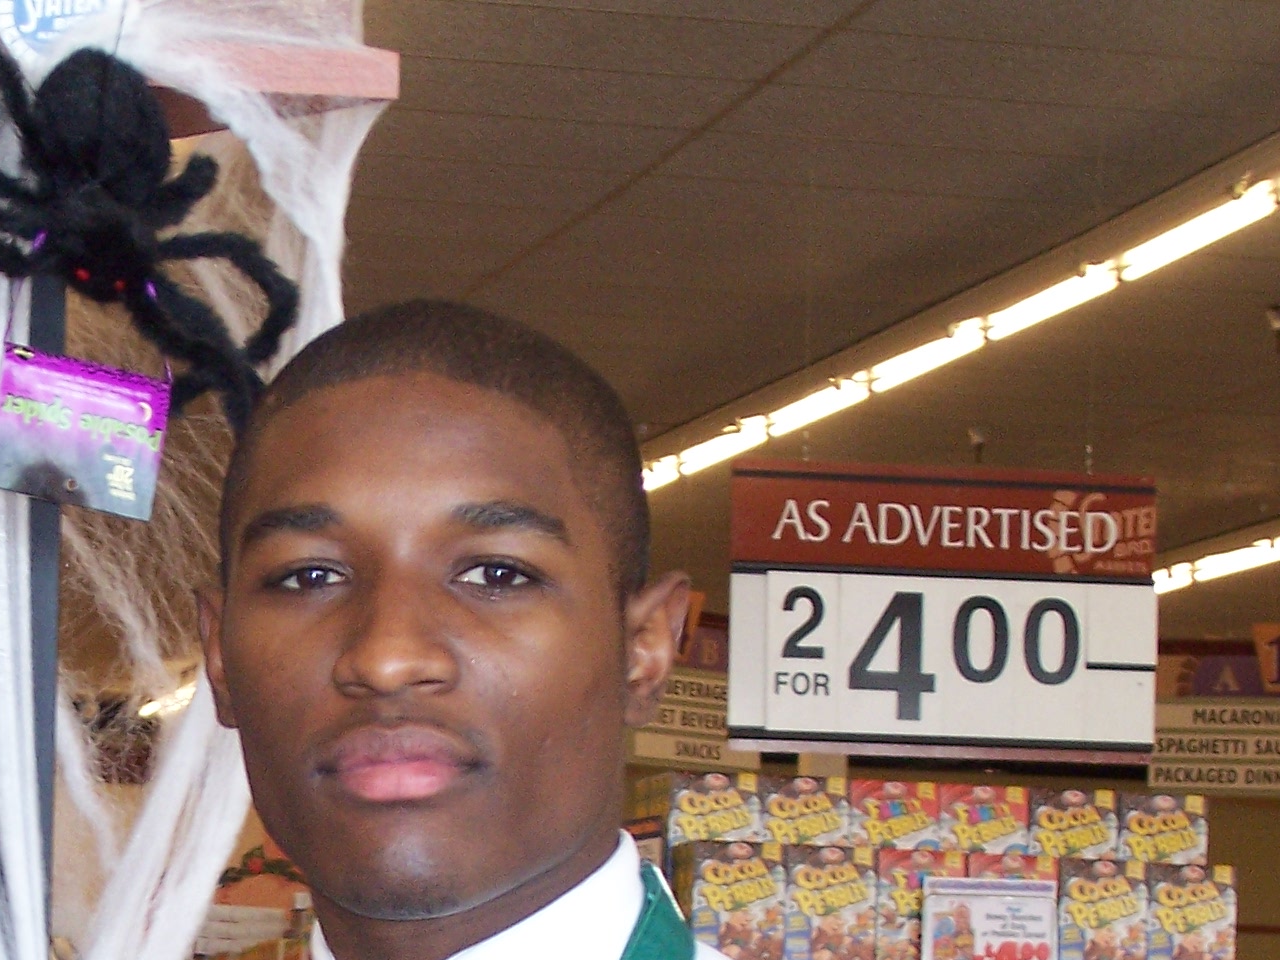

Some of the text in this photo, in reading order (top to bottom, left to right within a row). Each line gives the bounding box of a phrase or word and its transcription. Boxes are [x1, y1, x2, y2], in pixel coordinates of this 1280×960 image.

[772, 499, 831, 543] AS
[842, 502, 1118, 554] ADVERTISED
[782, 585, 825, 659] 2
[774, 671, 830, 696] FOR
[1212, 663, 1240, 692] A
[675, 741, 721, 761] SNACKS
[1156, 737, 1246, 755] SPAGHETTI
[1154, 766, 1238, 785] PACKAGED
